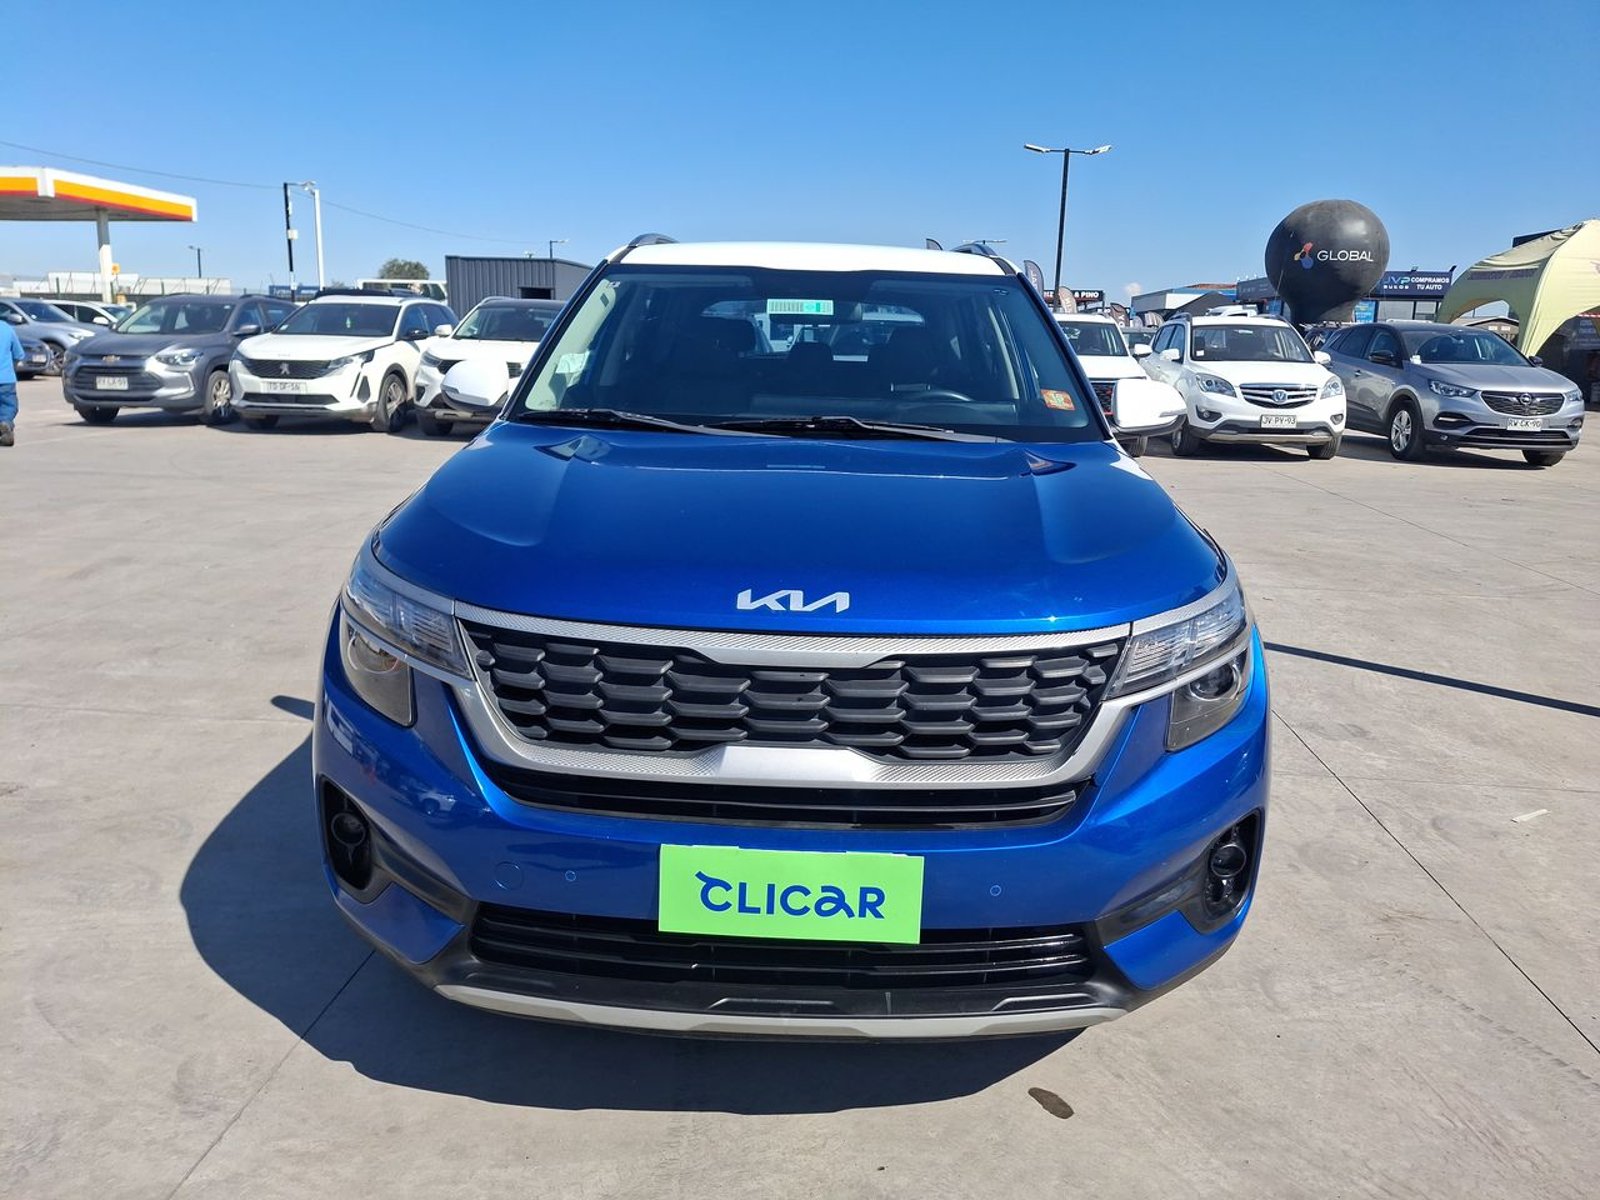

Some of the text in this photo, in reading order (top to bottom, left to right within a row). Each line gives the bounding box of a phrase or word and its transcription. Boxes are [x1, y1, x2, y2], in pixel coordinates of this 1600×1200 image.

[1317, 249, 1374, 262] GLOBAL
[1410, 276, 1450, 284] COMPRAMOS
[737, 588, 850, 613] KIA
